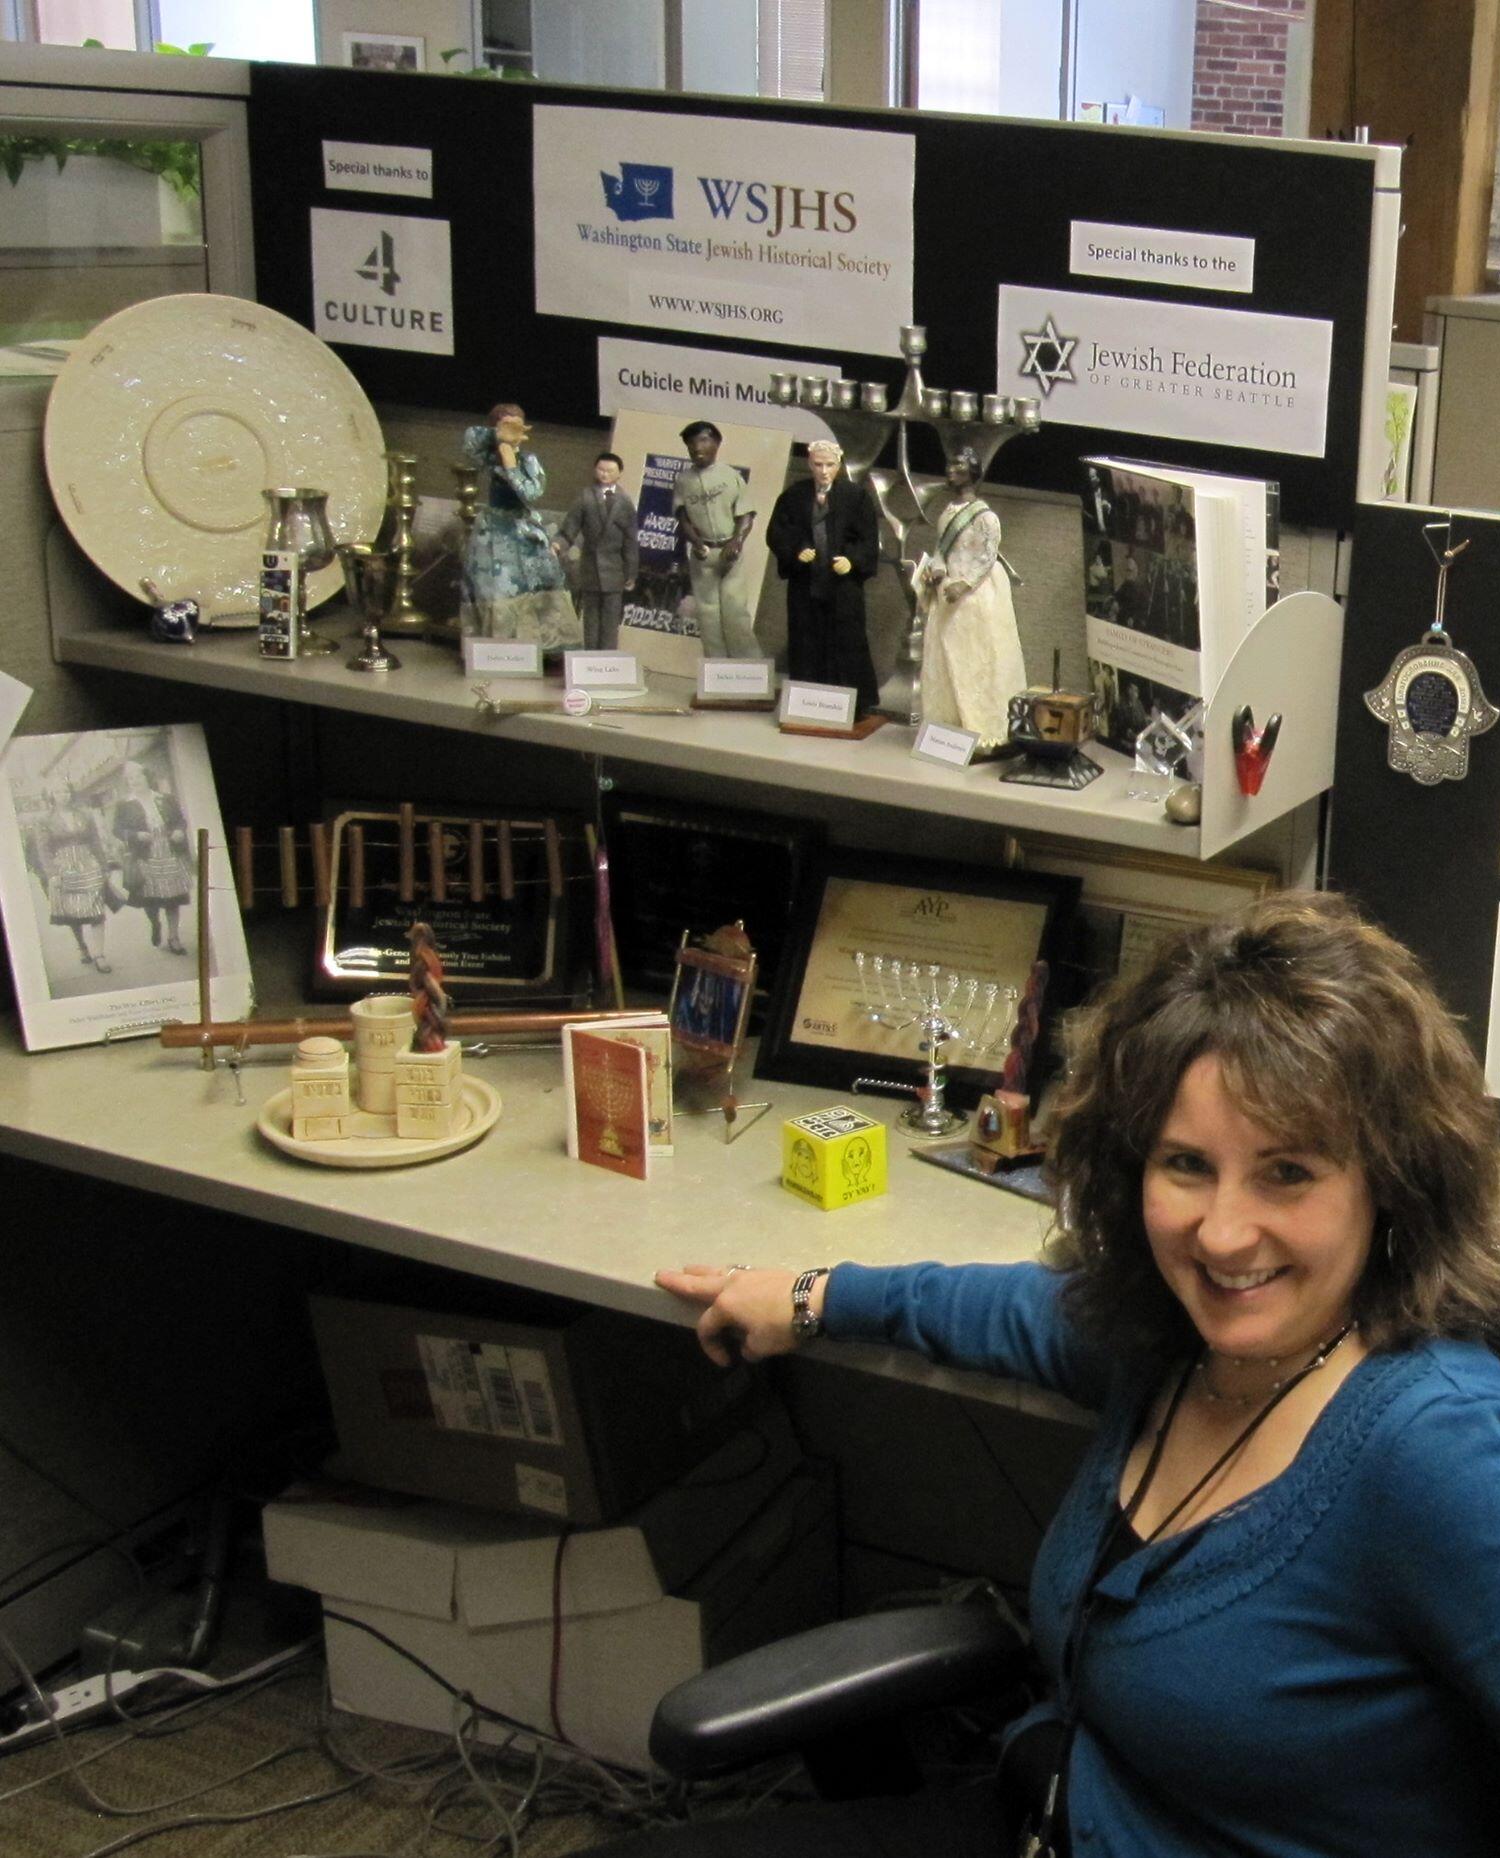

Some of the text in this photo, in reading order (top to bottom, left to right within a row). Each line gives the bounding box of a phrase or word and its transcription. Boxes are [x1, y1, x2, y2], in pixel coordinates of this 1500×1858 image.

[329, 160, 429, 181] Special thanks to
[697, 177, 857, 238] WSJHS
[355, 230, 401, 296] 4
[576, 223, 892, 278] Washington State Jewish Historical Society
[1087, 243, 1236, 272] Special thanks to the
[325, 300, 444, 333] CULTURE
[649, 294, 784, 325] WWW.WSJHS.ORG
[1087, 343, 1296, 389] Jewish Federation
[618, 368, 683, 393] Cubicle
[689, 377, 730, 399] Mini
[1089, 373, 1295, 408] OF GREATER SEATTLE
[914, 896, 950, 917] AYP
